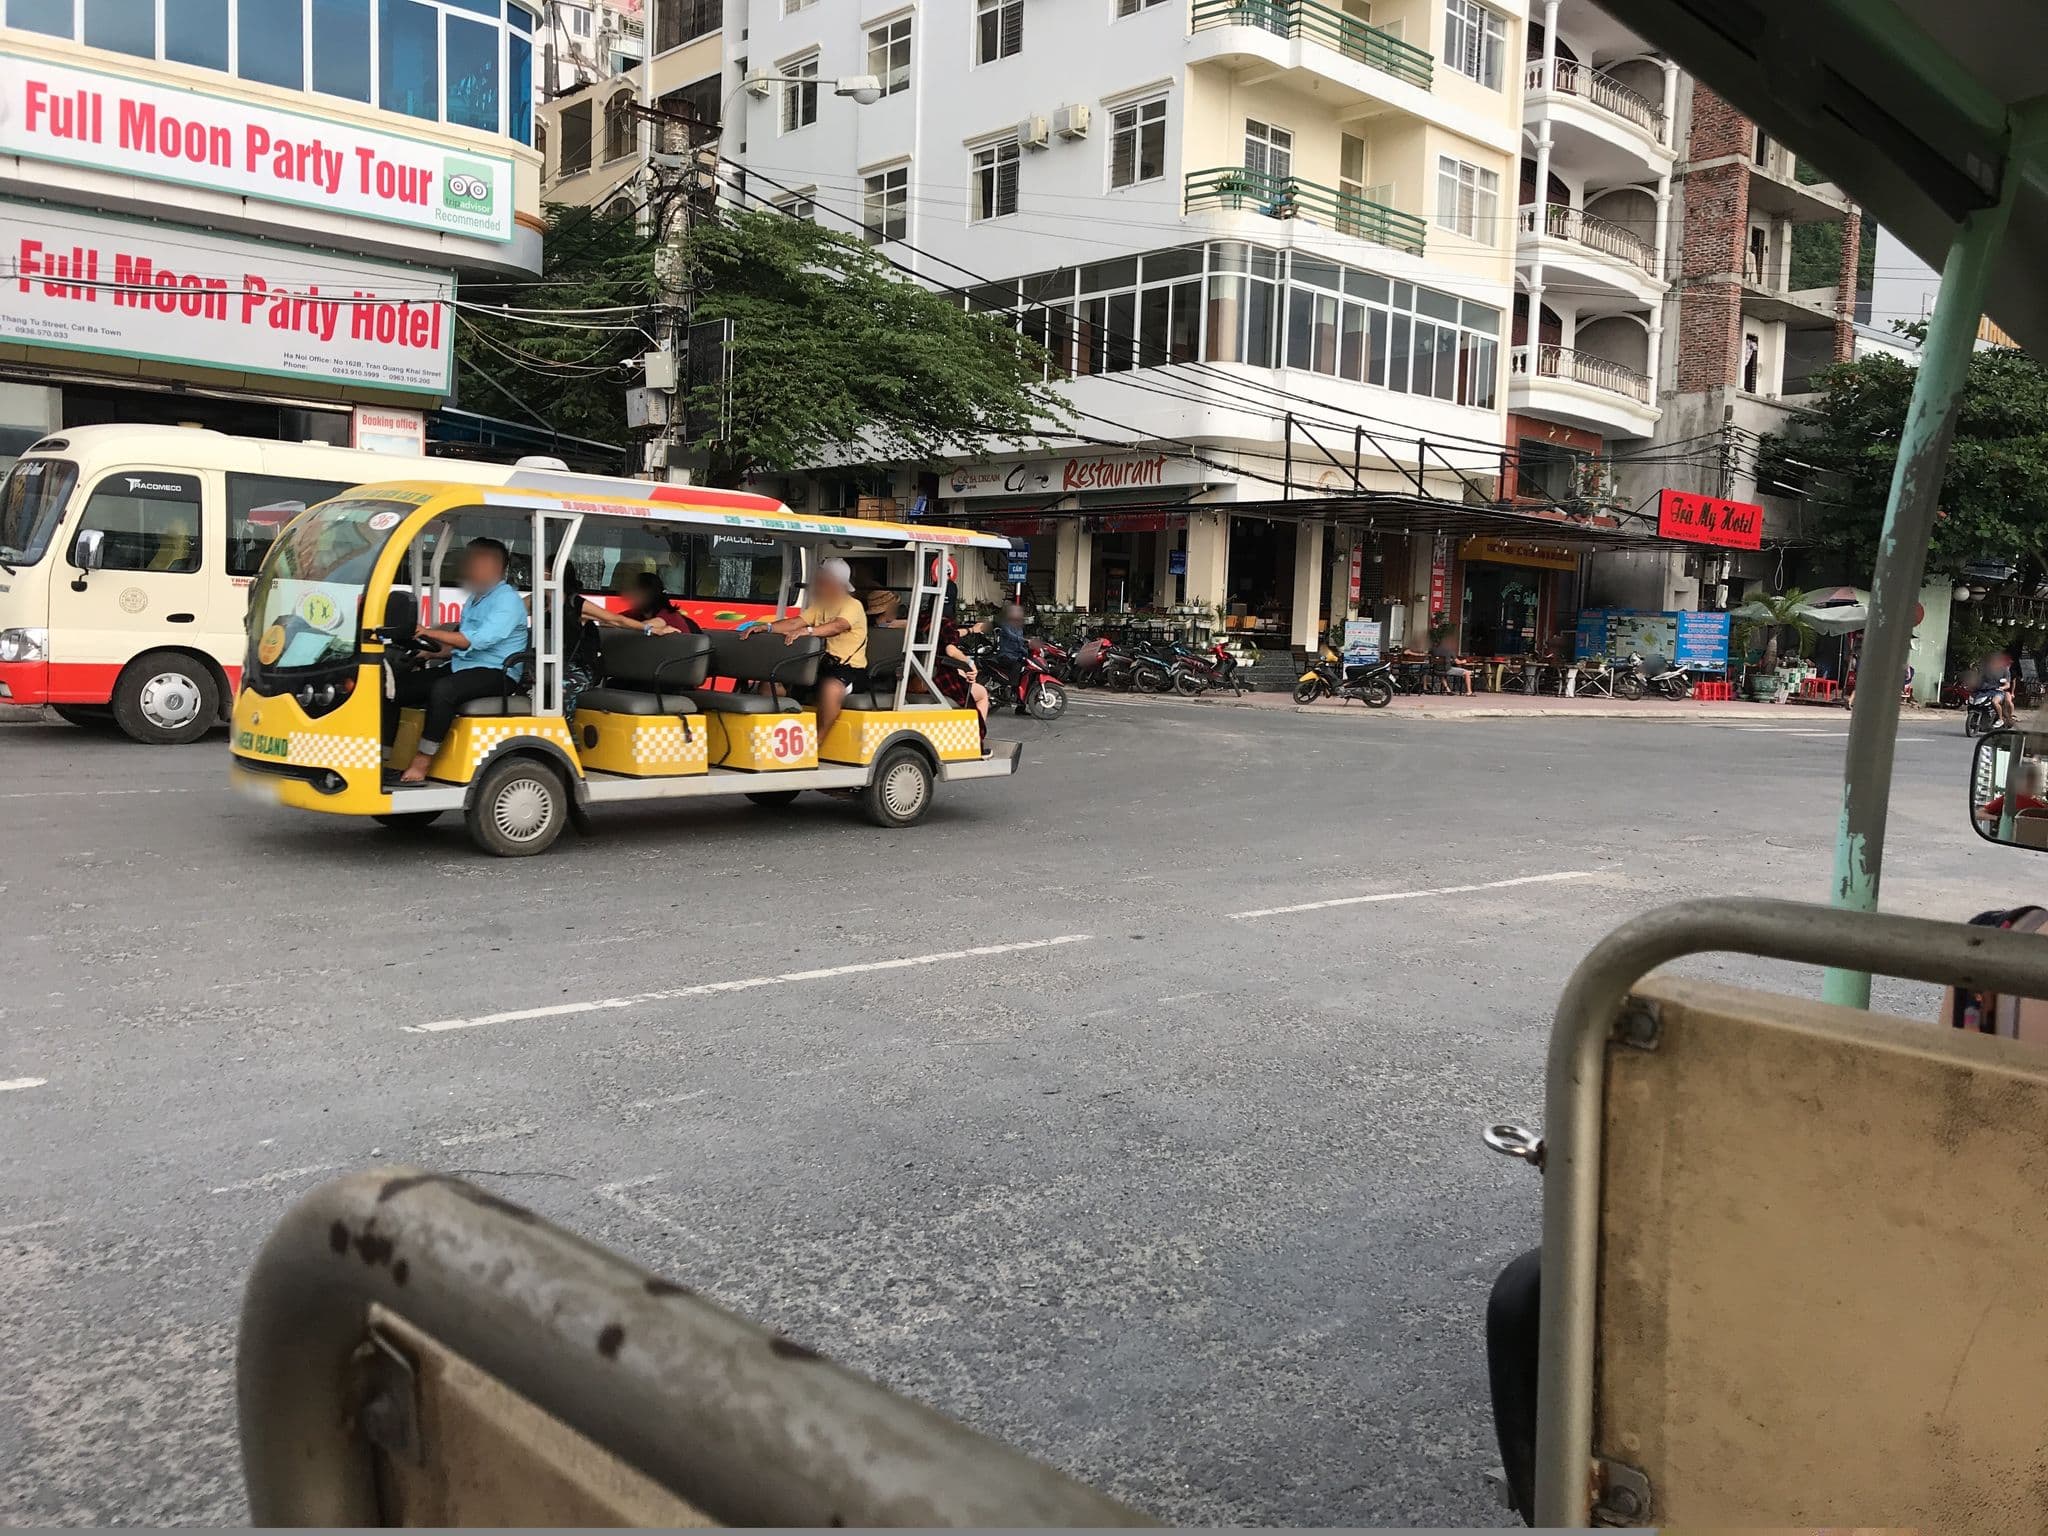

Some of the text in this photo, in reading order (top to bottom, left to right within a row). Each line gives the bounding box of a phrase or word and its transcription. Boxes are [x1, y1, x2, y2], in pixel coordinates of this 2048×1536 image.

[26, 80, 433, 206] Full Moon Party Tour
[445, 197, 492, 213] tripadvisor
[435, 207, 501, 231] Recommended
[19, 239, 441, 350] Full Moon Party Hotel
[2, 314, 27, 325] Thang
[30, 318, 39, 326] Tu
[71, 323, 85, 332] Cat
[101, 327, 122, 336] Town
[295, 353, 307, 361] Noi
[383, 364, 404, 374] Quang
[405, 367, 421, 375] Khai
[422, 370, 442, 378] Street
[362, 414, 418, 430] Booking office
[1062, 454, 1168, 492] Restaurant
[125, 477, 182, 493] TRACOMECO
[372, 514, 394, 528] 36
[1720, 505, 1756, 535] Hotel
[713, 534, 775, 549] TRACOMO
[255, 734, 288, 757] ISLAND
[773, 725, 804, 758] 36
